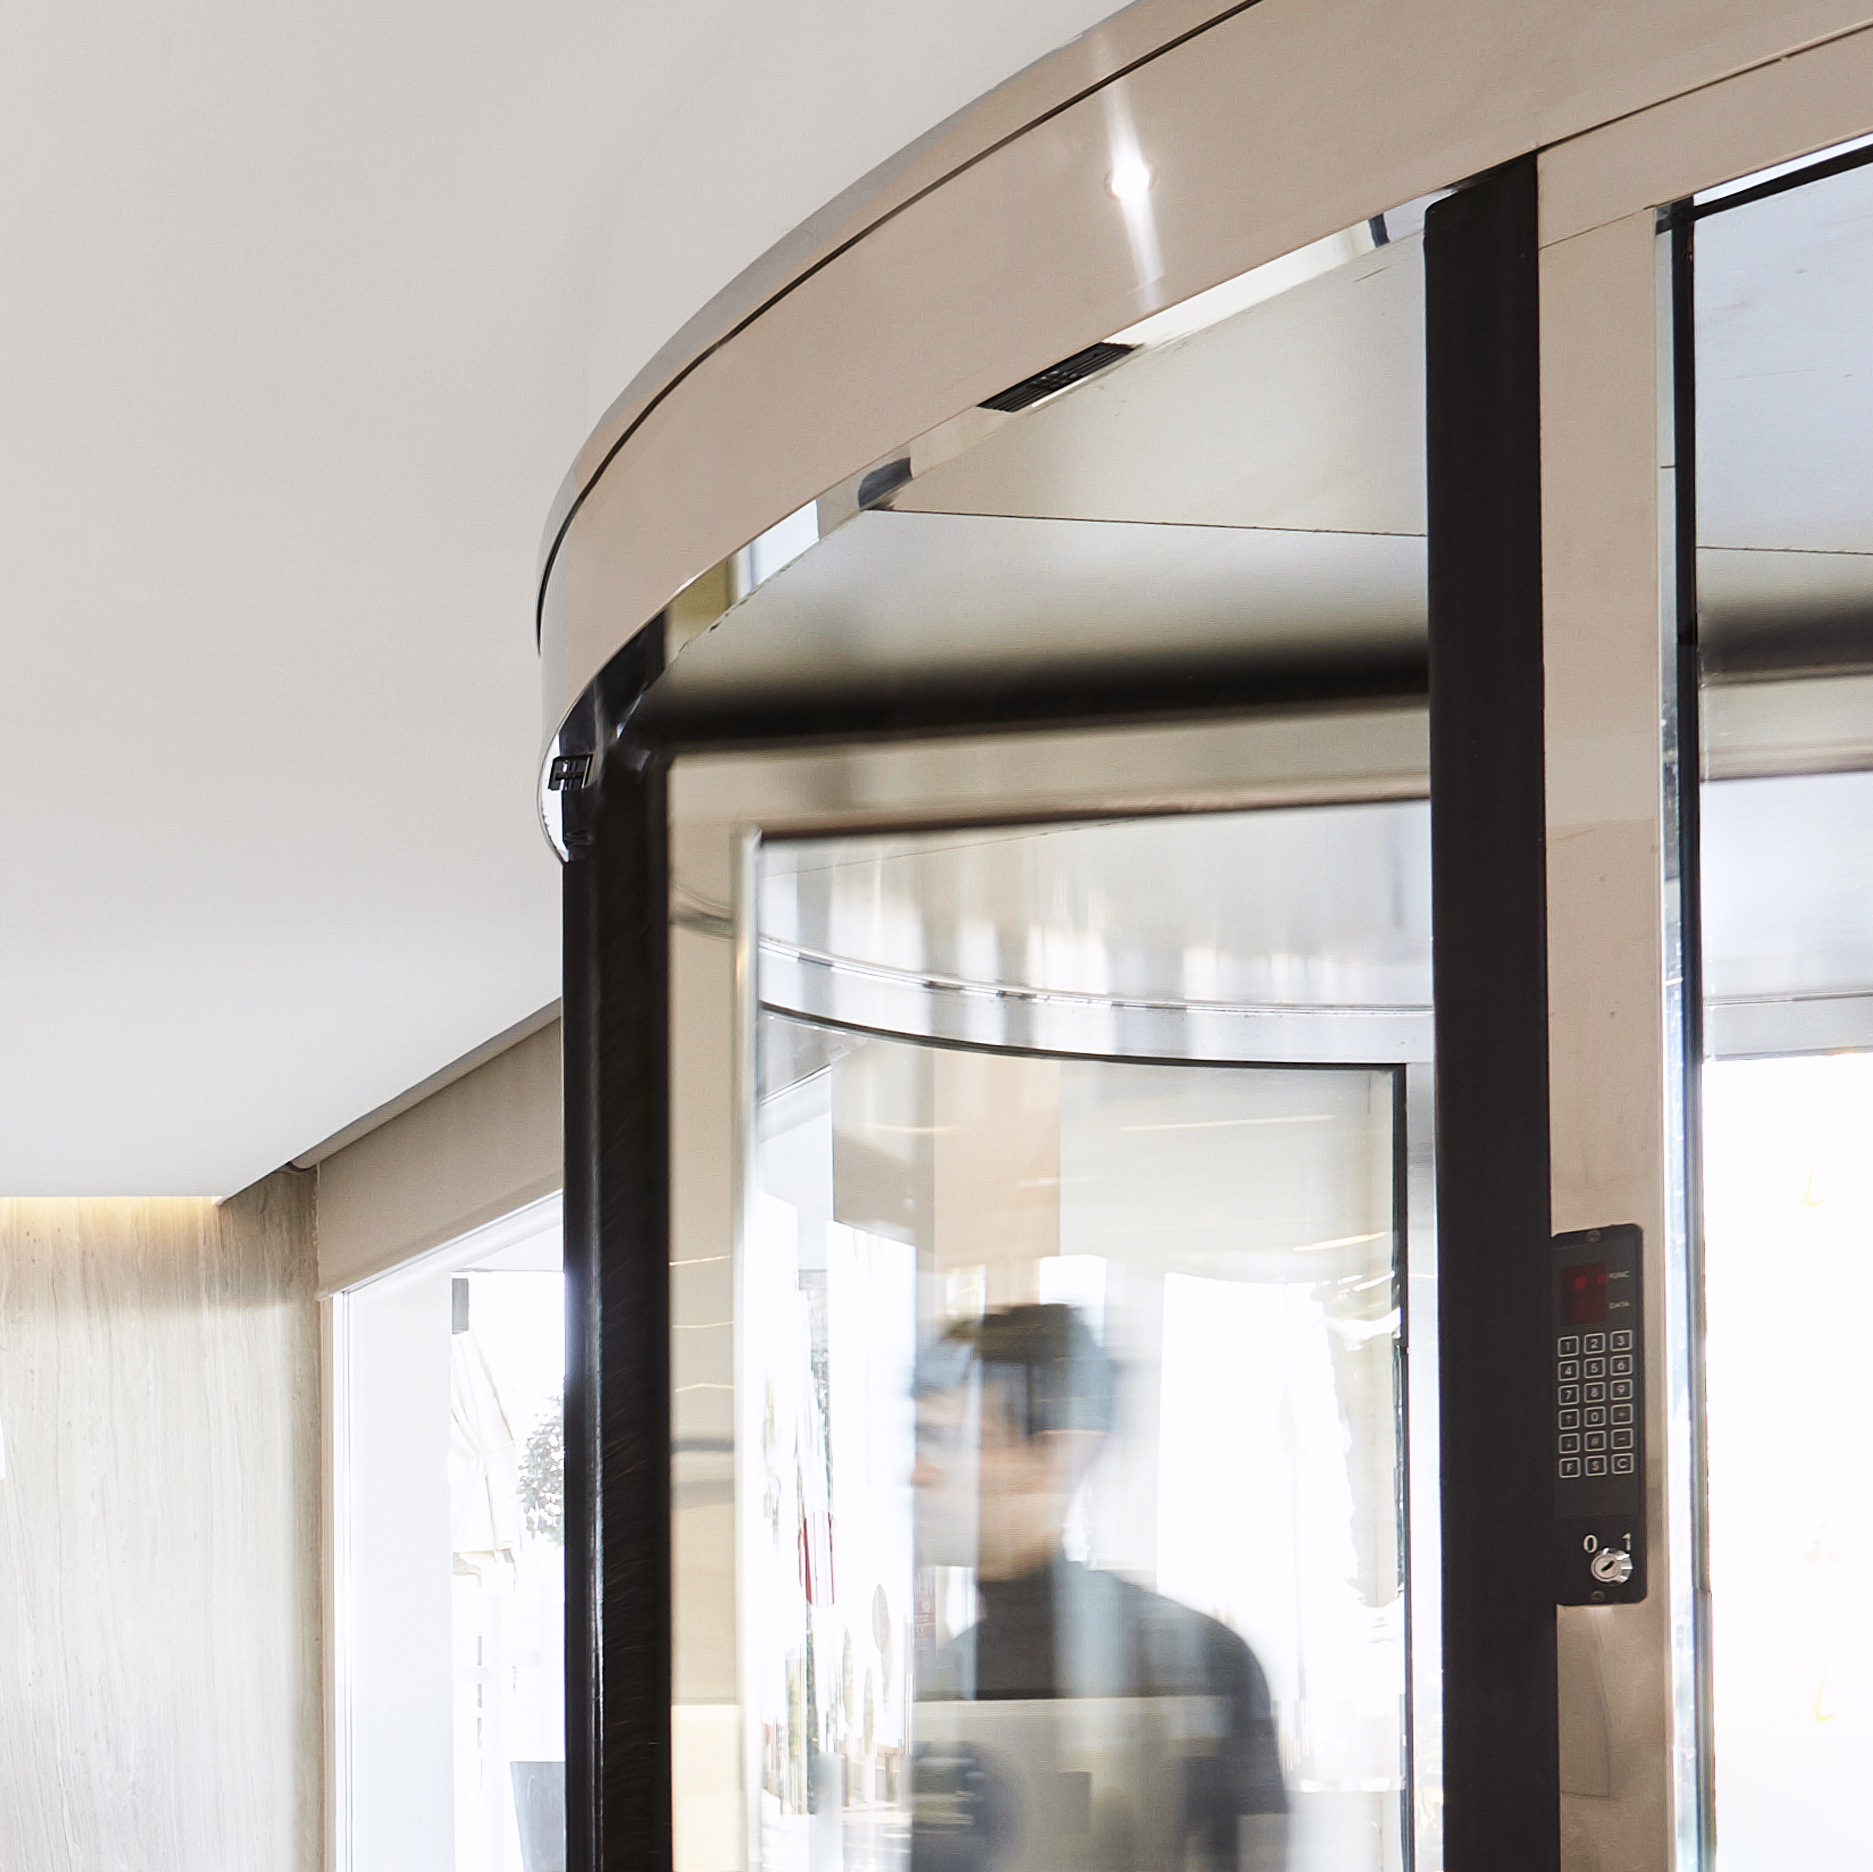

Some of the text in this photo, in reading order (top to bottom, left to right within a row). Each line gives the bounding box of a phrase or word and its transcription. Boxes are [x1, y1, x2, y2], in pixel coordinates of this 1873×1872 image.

[1590, 1338, 1599, 1349] 2
[1616, 1335, 1625, 1346] 3
[1564, 1361, 1626, 1376] 4 5 6
[1565, 1389, 1573, 1400] 7
[1590, 1387, 1599, 1398] 8
[1591, 1460, 1600, 1471] S
[1617, 1458, 1628, 1469] C
[1583, 1532, 1632, 1554] 0 1
